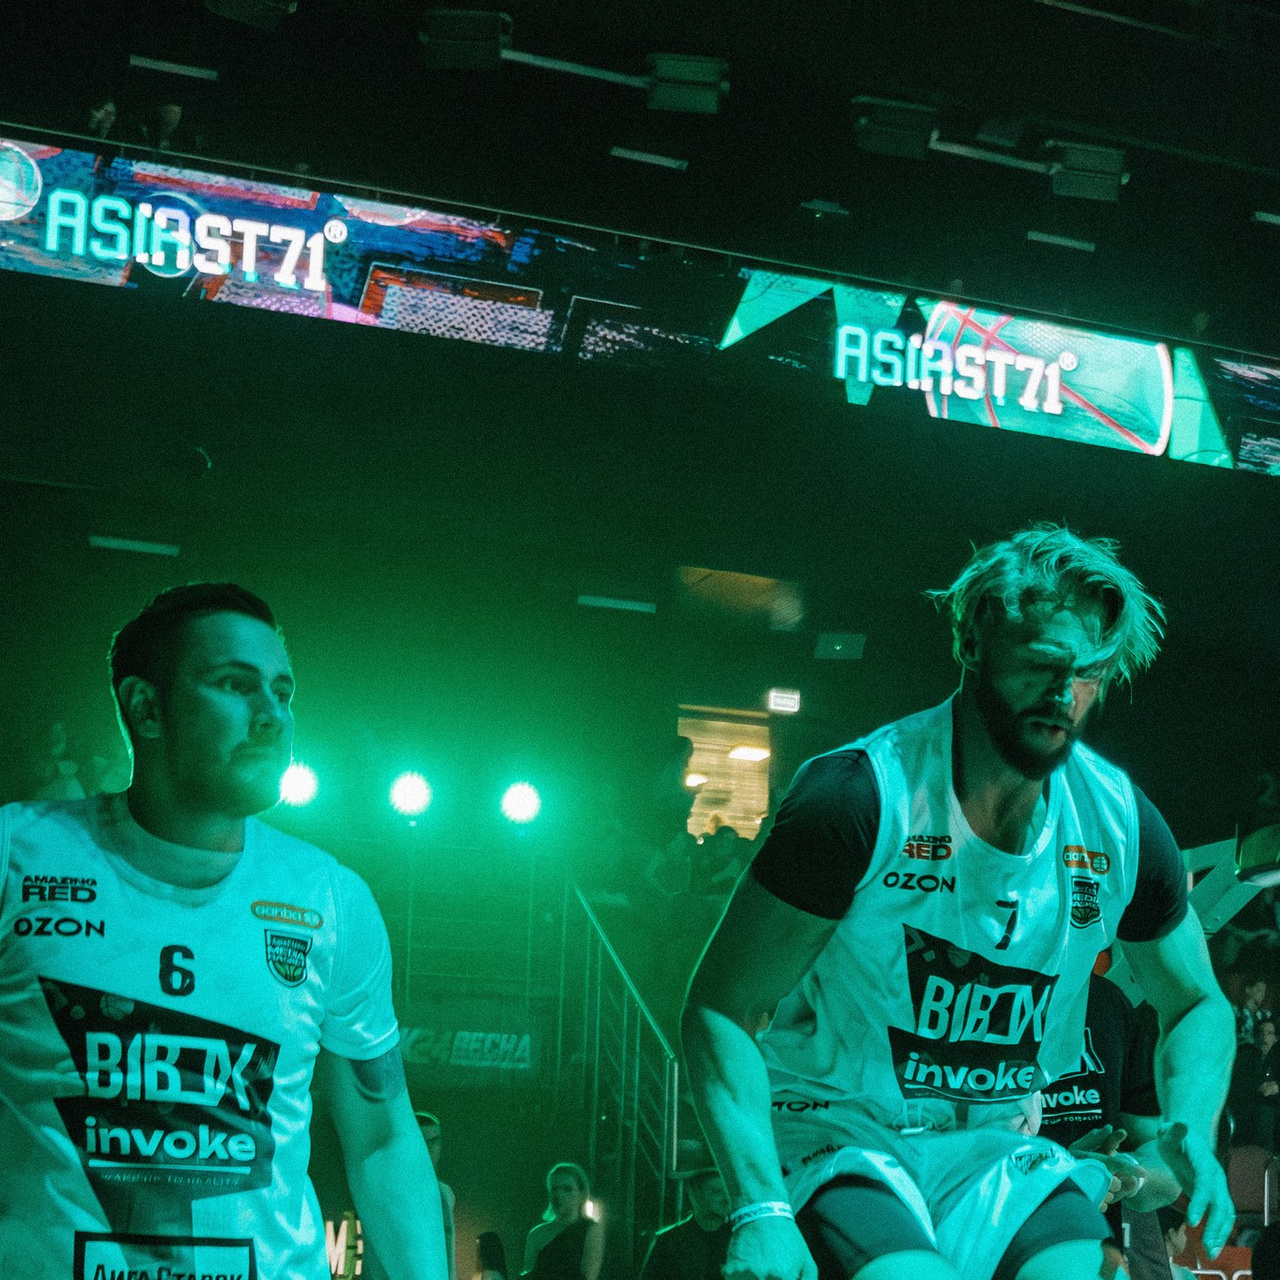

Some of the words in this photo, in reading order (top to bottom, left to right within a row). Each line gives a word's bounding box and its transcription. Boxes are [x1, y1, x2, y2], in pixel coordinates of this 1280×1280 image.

[22, 884, 97, 903] RED
[883, 871, 957, 894] OZON
[13, 916, 106, 939] OZON
[994, 899, 1020, 951] 7
[158, 944, 196, 996] 6
[903, 1052, 1036, 1092] invoke
[1040, 1085, 1101, 1109] nvoke
[85, 1116, 256, 1161] invoke
